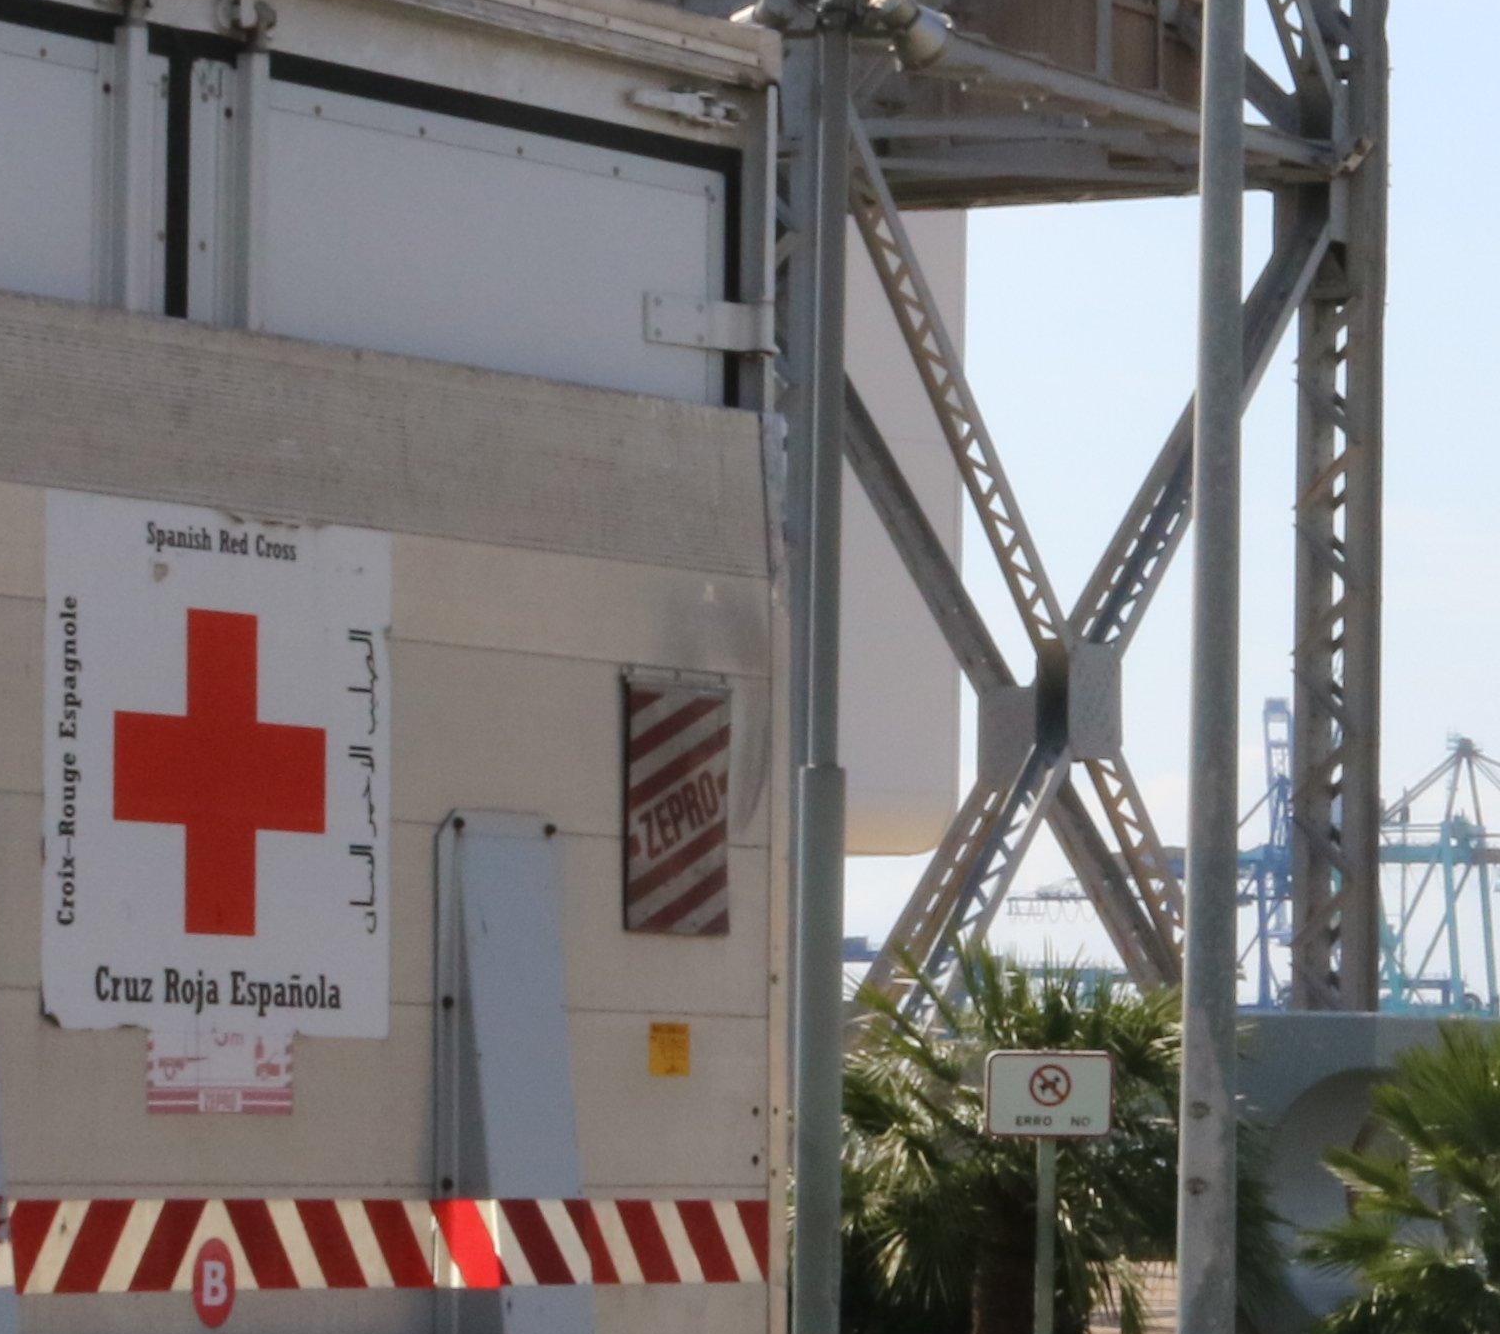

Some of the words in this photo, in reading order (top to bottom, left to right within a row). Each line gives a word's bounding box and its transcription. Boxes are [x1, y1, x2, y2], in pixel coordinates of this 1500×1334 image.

[146, 521, 212, 552] Spanish
[219, 530, 248, 555] Red
[255, 534, 297, 561] Cross
[59, 595, 82, 740] Espagnole
[638, 770, 719, 859] ZEPRO
[95, 966, 152, 1002] Cruz
[164, 968, 219, 1014] Roja
[230, 971, 341, 1016] Española
[1070, 1116, 1091, 1127] NO
[203, 1260, 227, 1306] B
